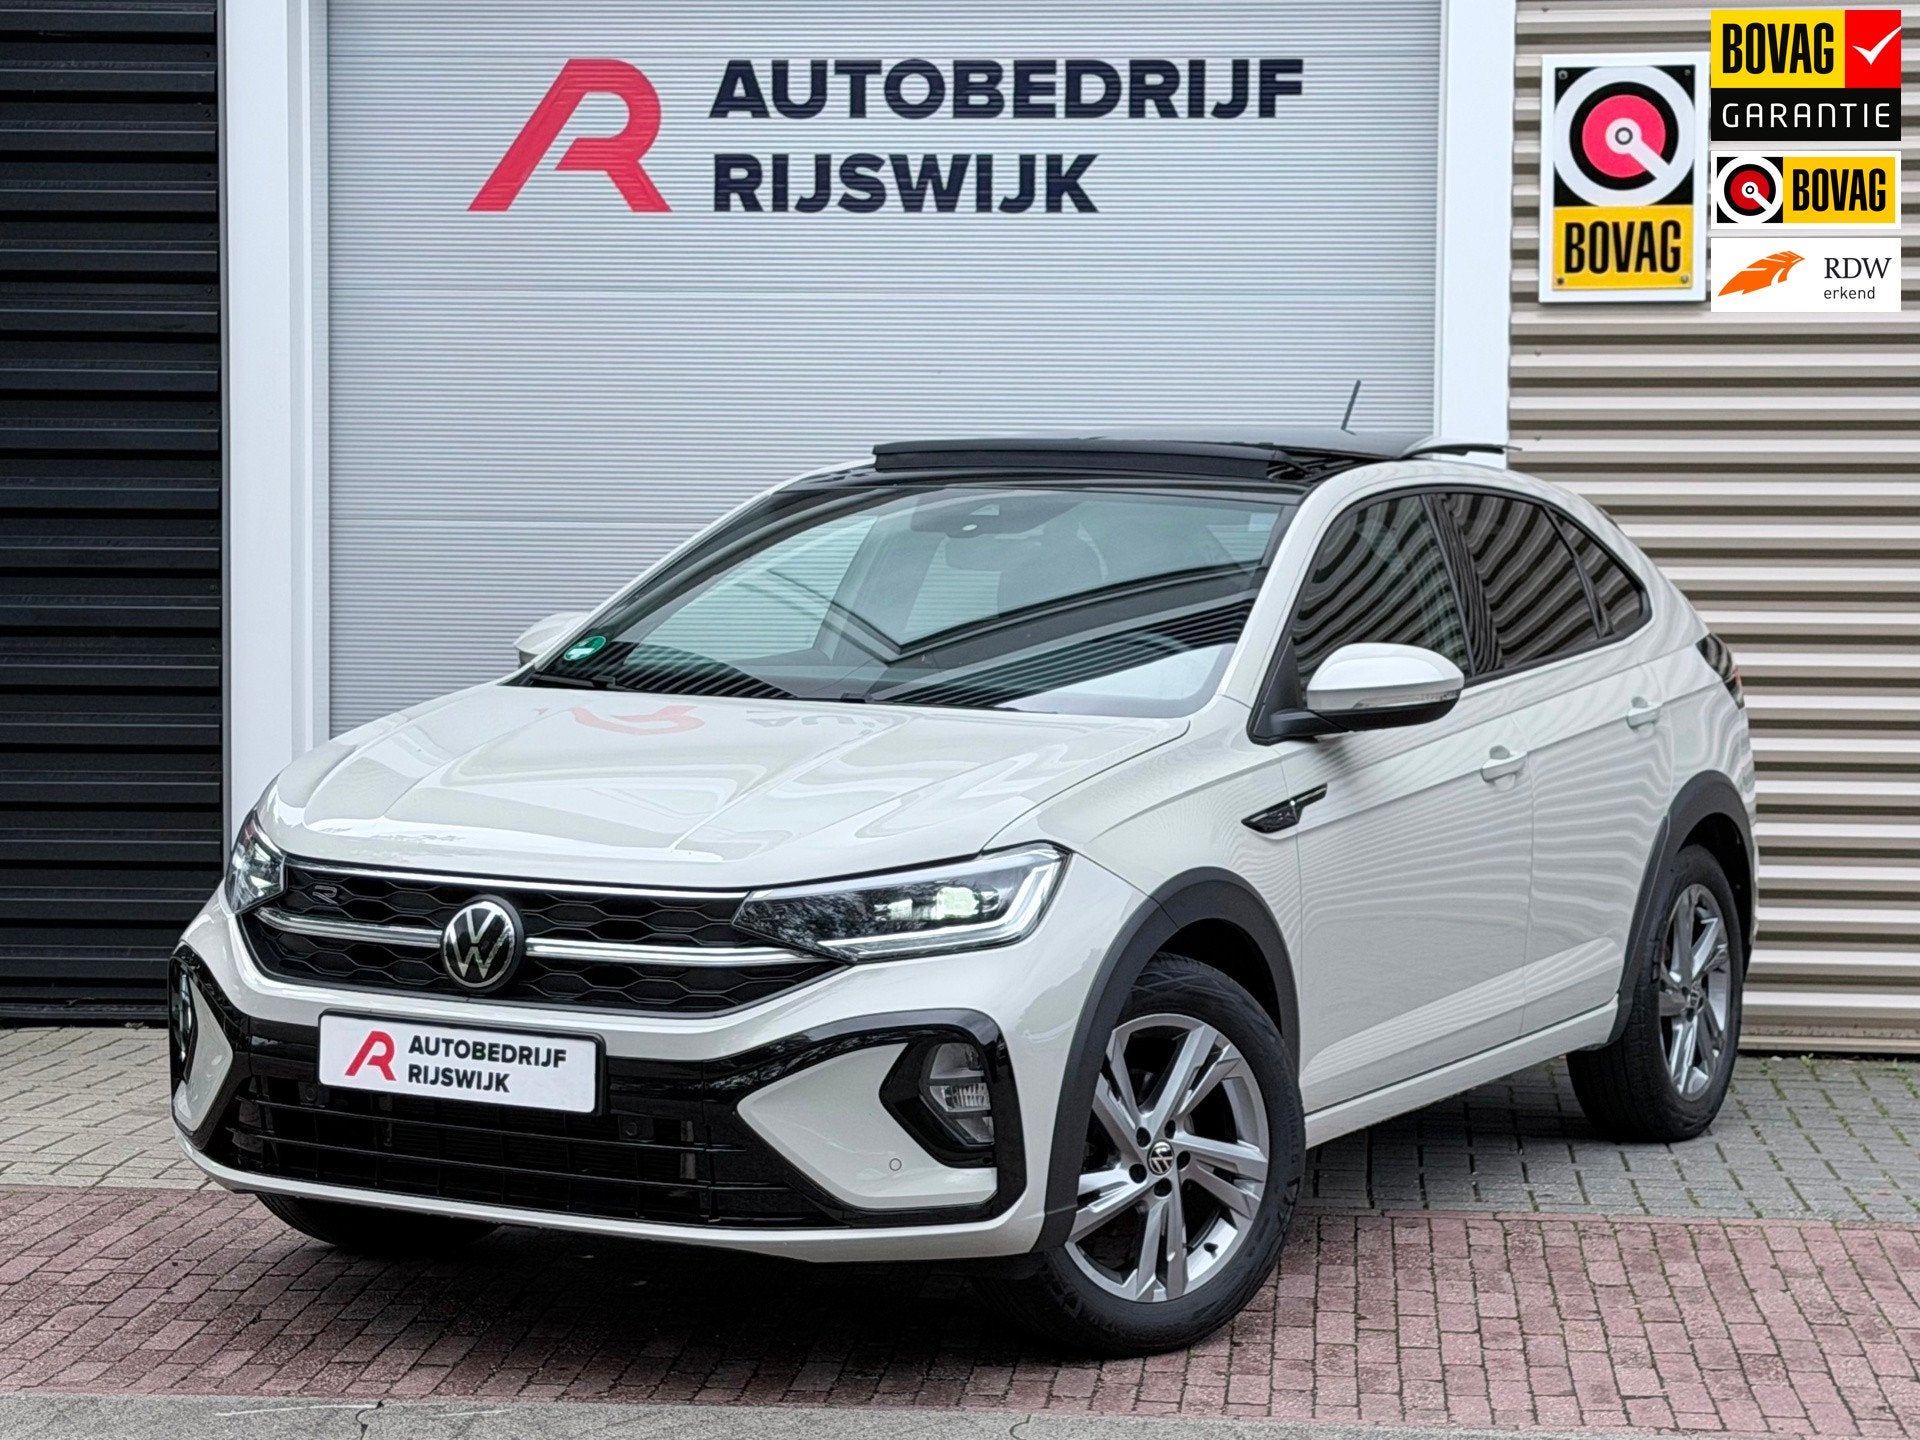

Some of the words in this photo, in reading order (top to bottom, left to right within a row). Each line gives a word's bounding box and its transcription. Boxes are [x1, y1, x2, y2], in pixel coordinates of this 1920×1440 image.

[709, 58, 1304, 120] AUTOBEDRIJF
[713, 152, 1098, 214] RIJSWIJK
[1564, 219, 1682, 275] BOVAG
[408, 1035, 567, 1069] AUTOBEDRIJF
[408, 1065, 510, 1093] RIJSWIJK
